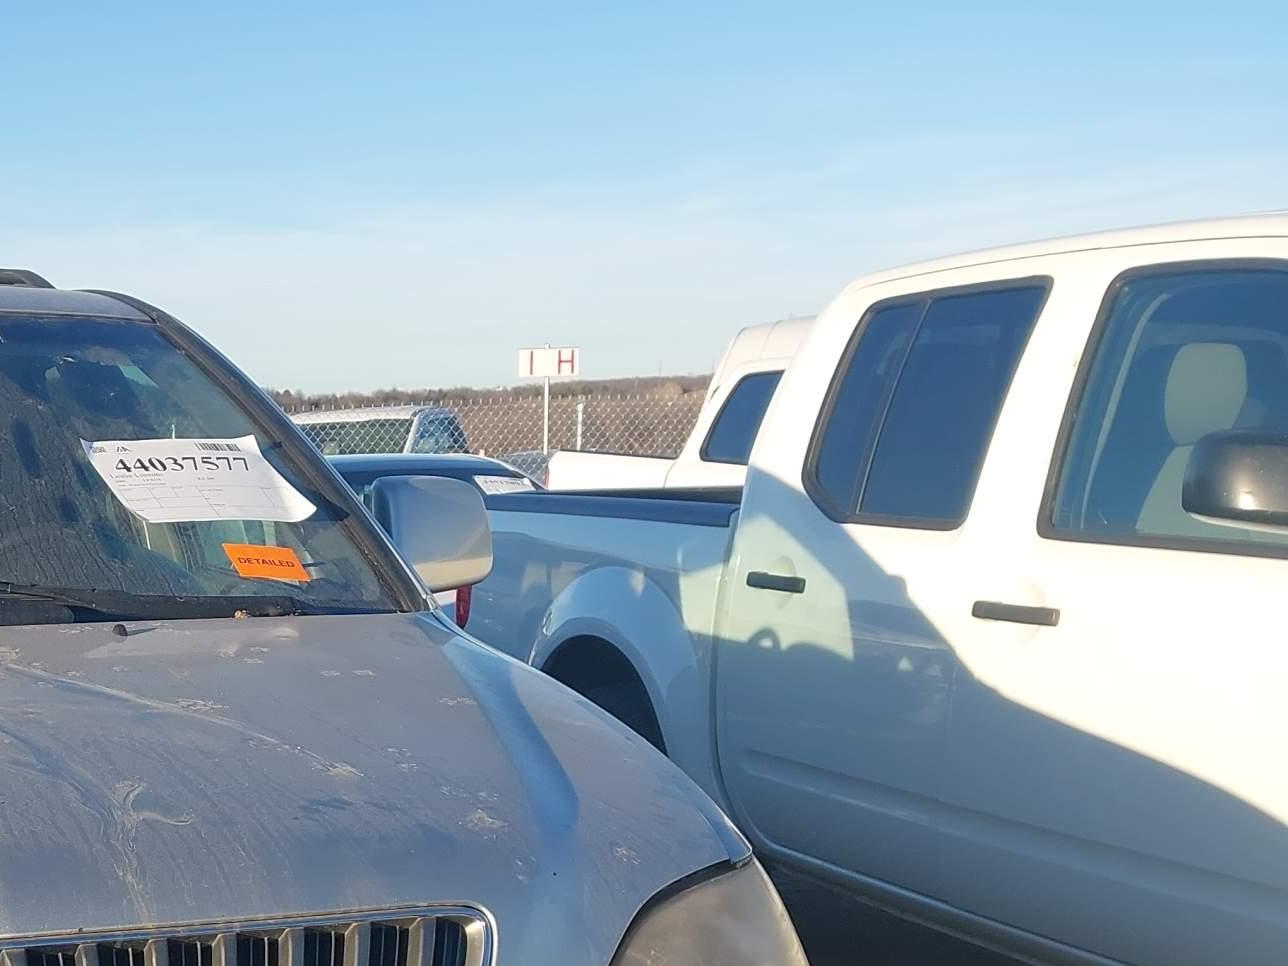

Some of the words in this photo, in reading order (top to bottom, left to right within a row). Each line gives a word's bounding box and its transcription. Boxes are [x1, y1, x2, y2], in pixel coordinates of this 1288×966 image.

[557, 349, 574, 374] H
[115, 456, 249, 473] 44037577
[237, 557, 295, 568] DETAILED
